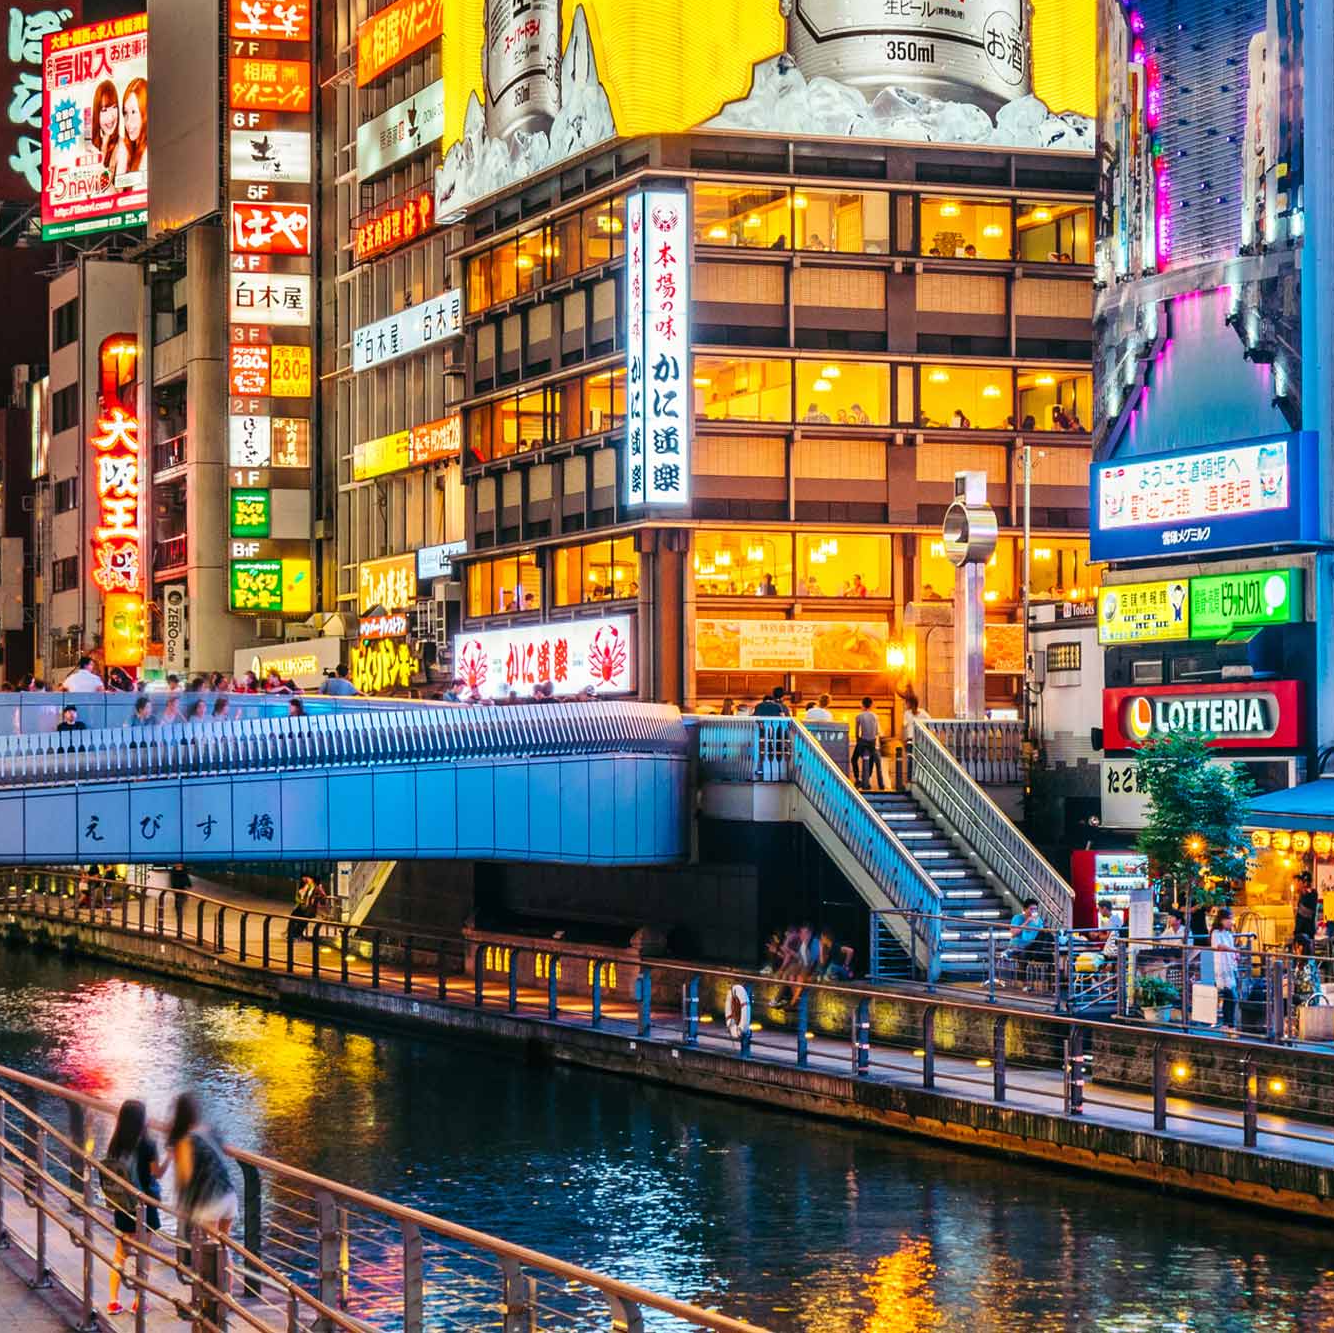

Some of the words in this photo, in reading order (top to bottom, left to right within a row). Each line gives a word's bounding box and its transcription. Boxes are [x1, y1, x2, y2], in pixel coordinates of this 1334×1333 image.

[54, 47, 113, 89] 高収入
[886, 41, 935, 64] 350ml
[247, 185, 269, 199] 5F
[234, 209, 308, 249] はや
[232, 256, 260, 270] 4F
[235, 280, 304, 310] 白木屋
[653, 240, 678, 342] 本場の味
[234, 471, 260, 485] 1F
[93, 410, 139, 593] 大阪王将
[167, 606, 179, 637] ZERO
[1072, 602, 1095, 617] Toilets
[1155, 697, 1265, 733] LOTTERIA
[84, 811, 276, 842] えびす橋
